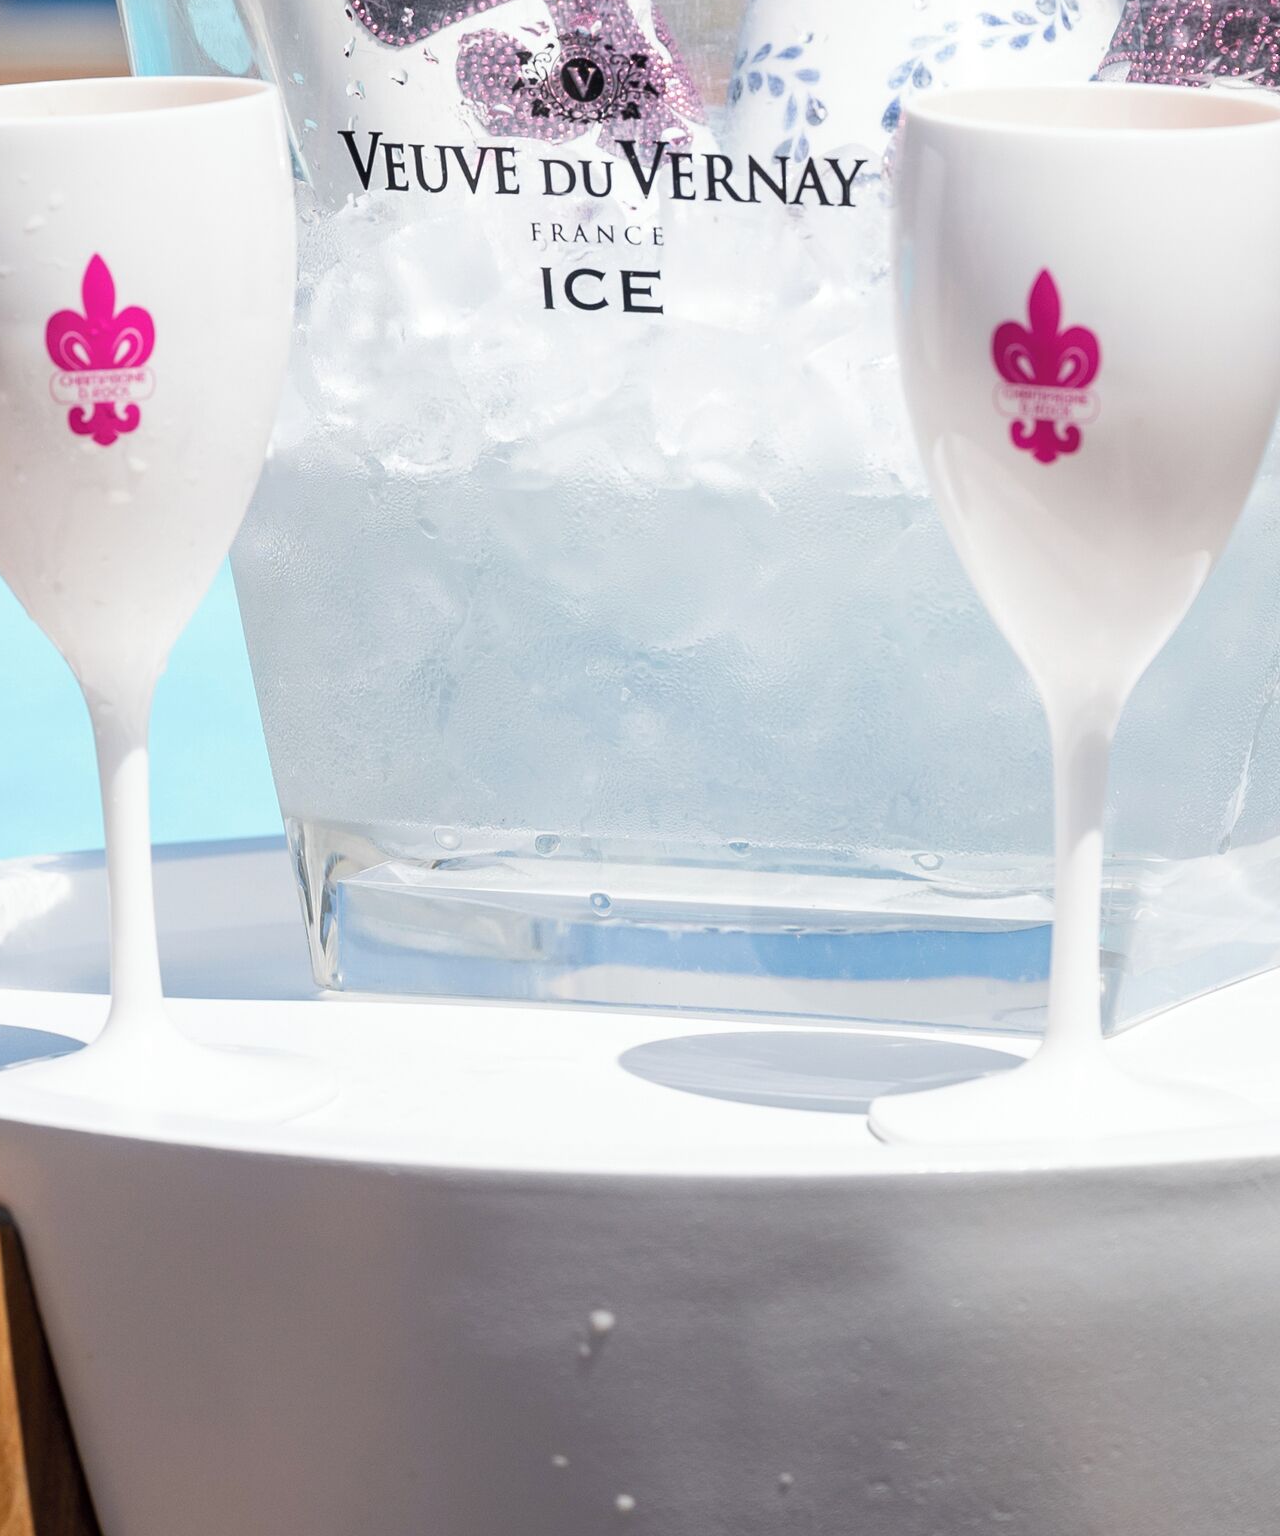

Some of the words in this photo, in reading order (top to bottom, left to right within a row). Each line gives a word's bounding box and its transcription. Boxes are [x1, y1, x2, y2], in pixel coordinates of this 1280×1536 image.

[337, 130, 521, 195] VEUVE
[540, 158, 613, 198] DU
[614, 139, 868, 207] VERNAY
[530, 221, 665, 247] FRANCE
[540, 266, 665, 315] ICE
